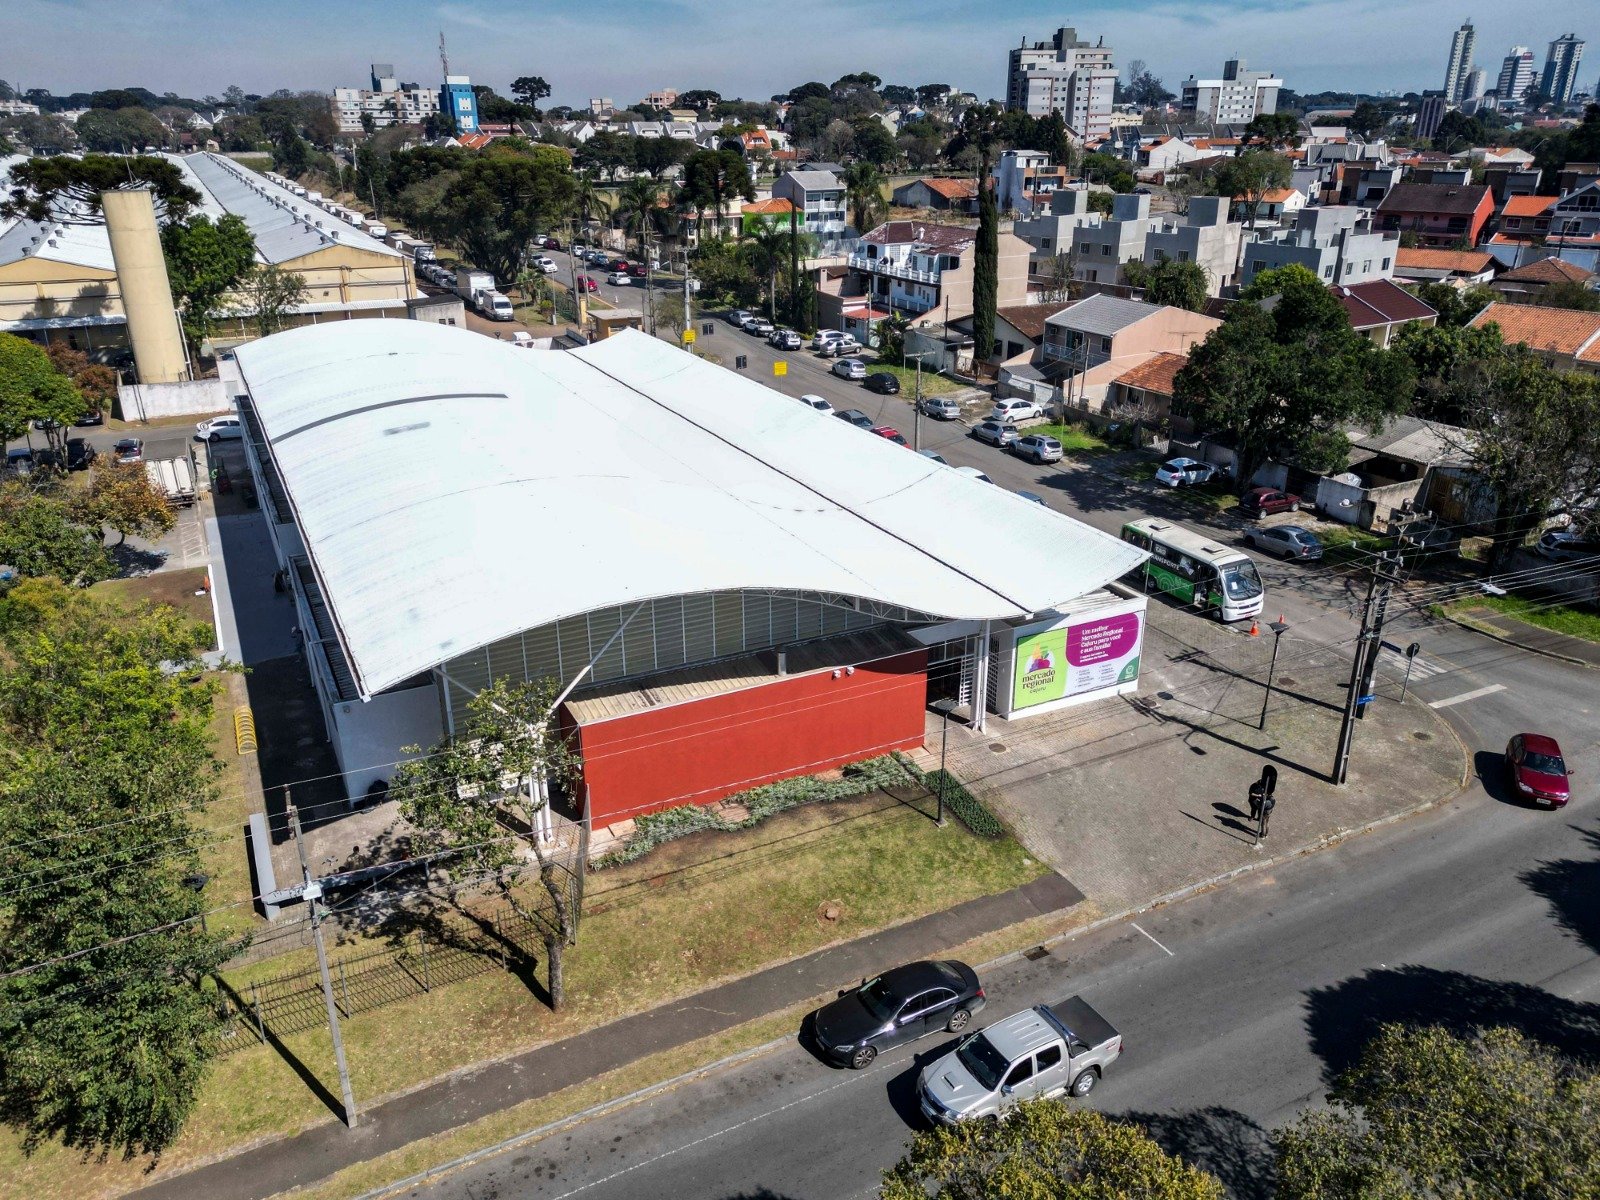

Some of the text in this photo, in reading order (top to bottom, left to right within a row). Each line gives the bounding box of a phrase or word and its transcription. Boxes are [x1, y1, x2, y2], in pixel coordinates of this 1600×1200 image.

[1082, 627, 1123, 641] Mercado Regional
[1022, 669, 1056, 683] mercado
[1022, 675, 1054, 689] regional
[1029, 686, 1047, 694] cajuru
